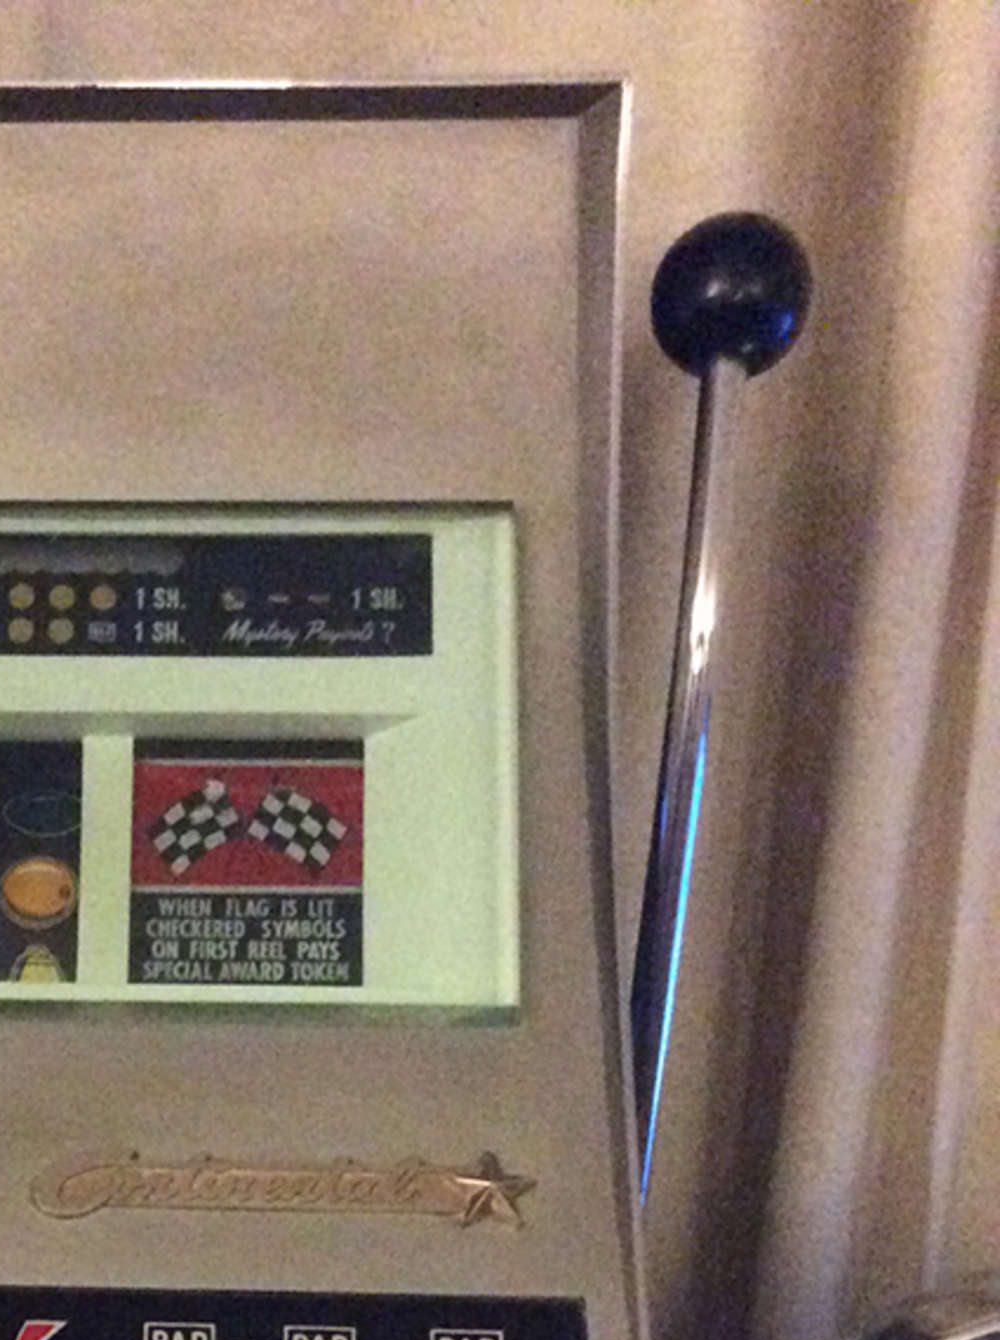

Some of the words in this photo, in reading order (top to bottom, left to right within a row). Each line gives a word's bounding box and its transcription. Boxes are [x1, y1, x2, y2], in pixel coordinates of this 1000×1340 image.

[136, 588, 145, 610] 1
[352, 589, 360, 610] 1
[134, 622, 143, 643] 1
[158, 899, 213, 916] WHEN
[225, 899, 270, 917] FLAG
[281, 899, 298, 916] IS
[308, 899, 336, 916] LIT
[145, 919, 246, 938] CHECKERED
[260, 919, 348, 939] SYMBOLS
[152, 940, 180, 959] ON
[189, 940, 239, 960] FIRST
[247, 941, 287, 960] REEL
[297, 941, 341, 960] PAYS
[143, 961, 213, 981] SPECIAL
[218, 961, 285, 981] AWARD
[291, 962, 349, 981] TOKEN
